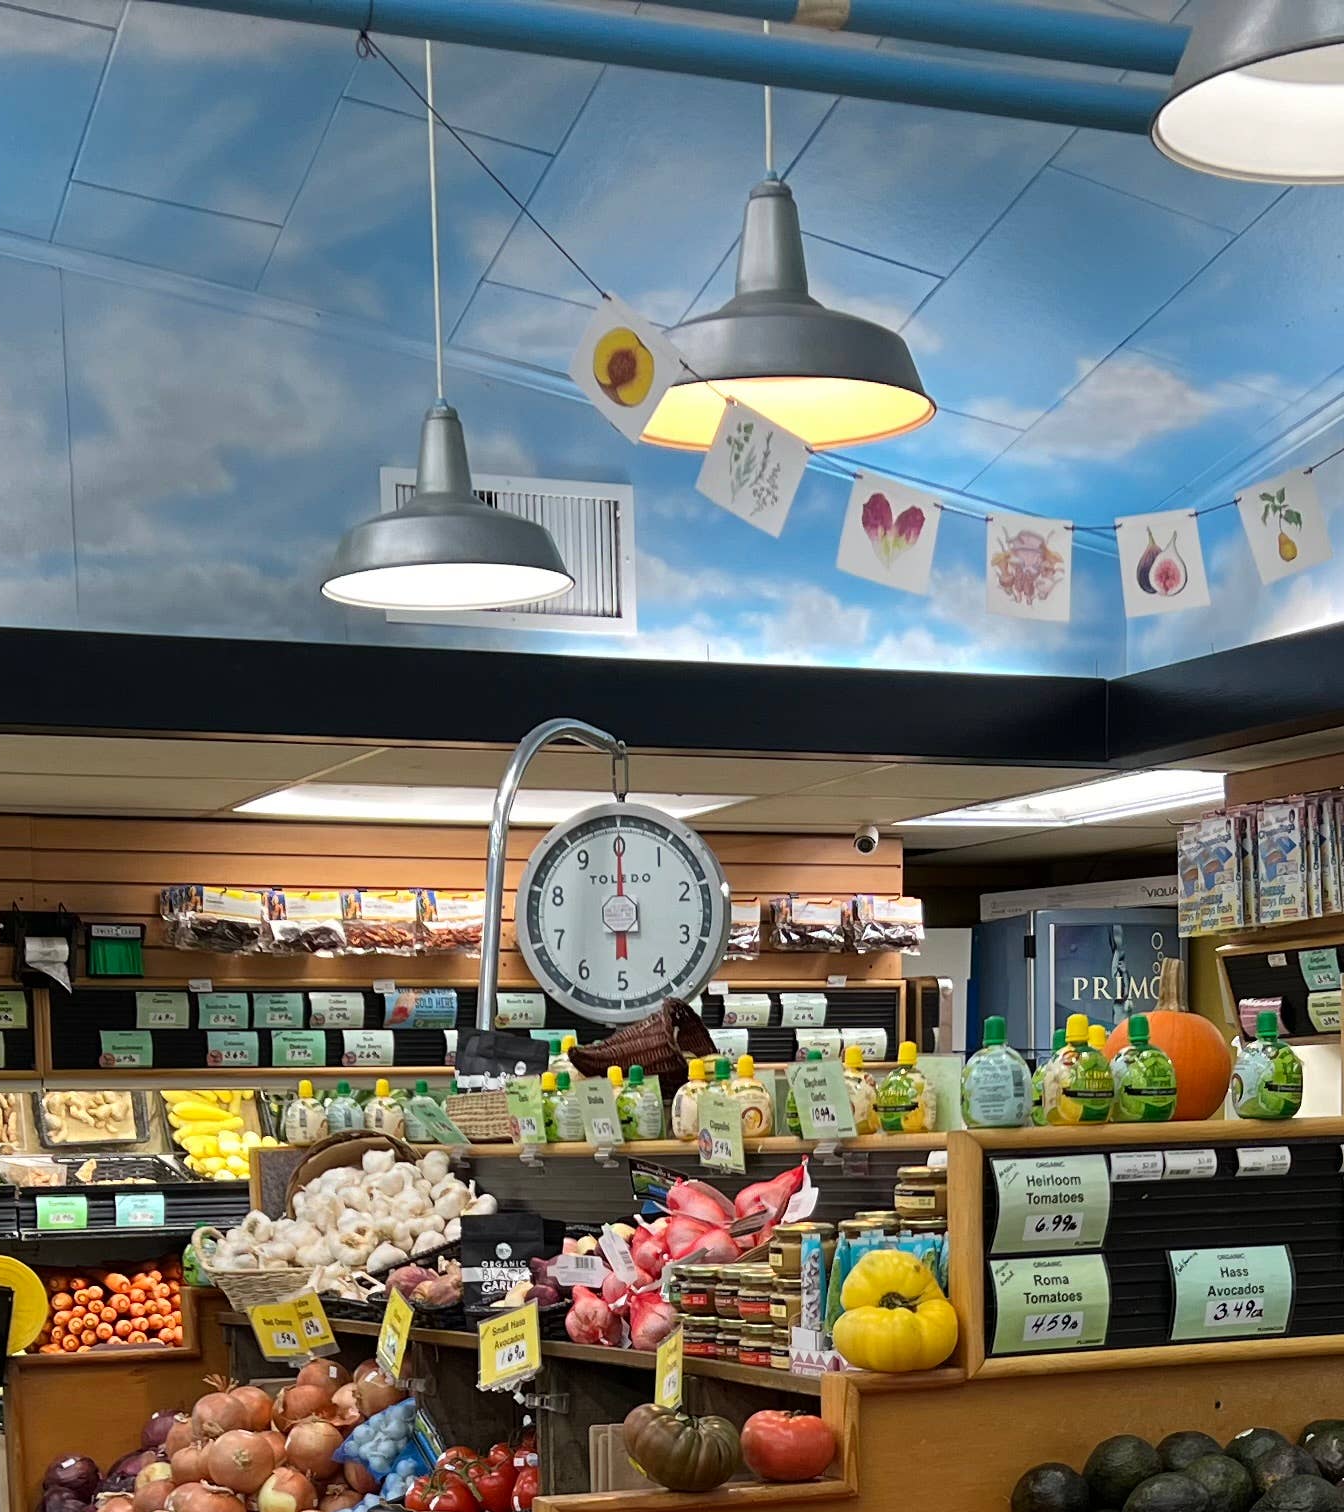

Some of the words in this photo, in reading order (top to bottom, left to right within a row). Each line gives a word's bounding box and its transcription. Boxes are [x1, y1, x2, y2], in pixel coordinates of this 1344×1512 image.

[613, 836, 626, 857] 0
[577, 849, 589, 870] 9
[656, 847, 662, 867] 1
[589, 873, 651, 884] TOLEDO
[552, 886, 564, 906] 8
[678, 882, 691, 902] 2
[554, 929, 565, 950] 7
[679, 924, 690, 944] 3
[578, 960, 590, 980] 6
[653, 957, 666, 977] 4
[618, 971, 629, 991] 5
[1036, 1161, 1067, 1169] ORGANIC
[1026, 1174, 1082, 1187] Heirloom
[1026, 1191, 1085, 1206] Tomatoes
[481, 1259, 527, 1269] ORGANIC
[1216, 1253, 1247, 1262] ORGANIC
[482, 1268, 530, 1280] BLACK
[1033, 1273, 1070, 1287] Roma
[1220, 1266, 1249, 1279] Hass
[481, 1279, 524, 1293] GARLI
[1207, 1283, 1265, 1298] Avocados
[1023, 1291, 1084, 1305] Tomatoes
[492, 1322, 509, 1337] Small
[494, 1332, 525, 1349] Avocados
